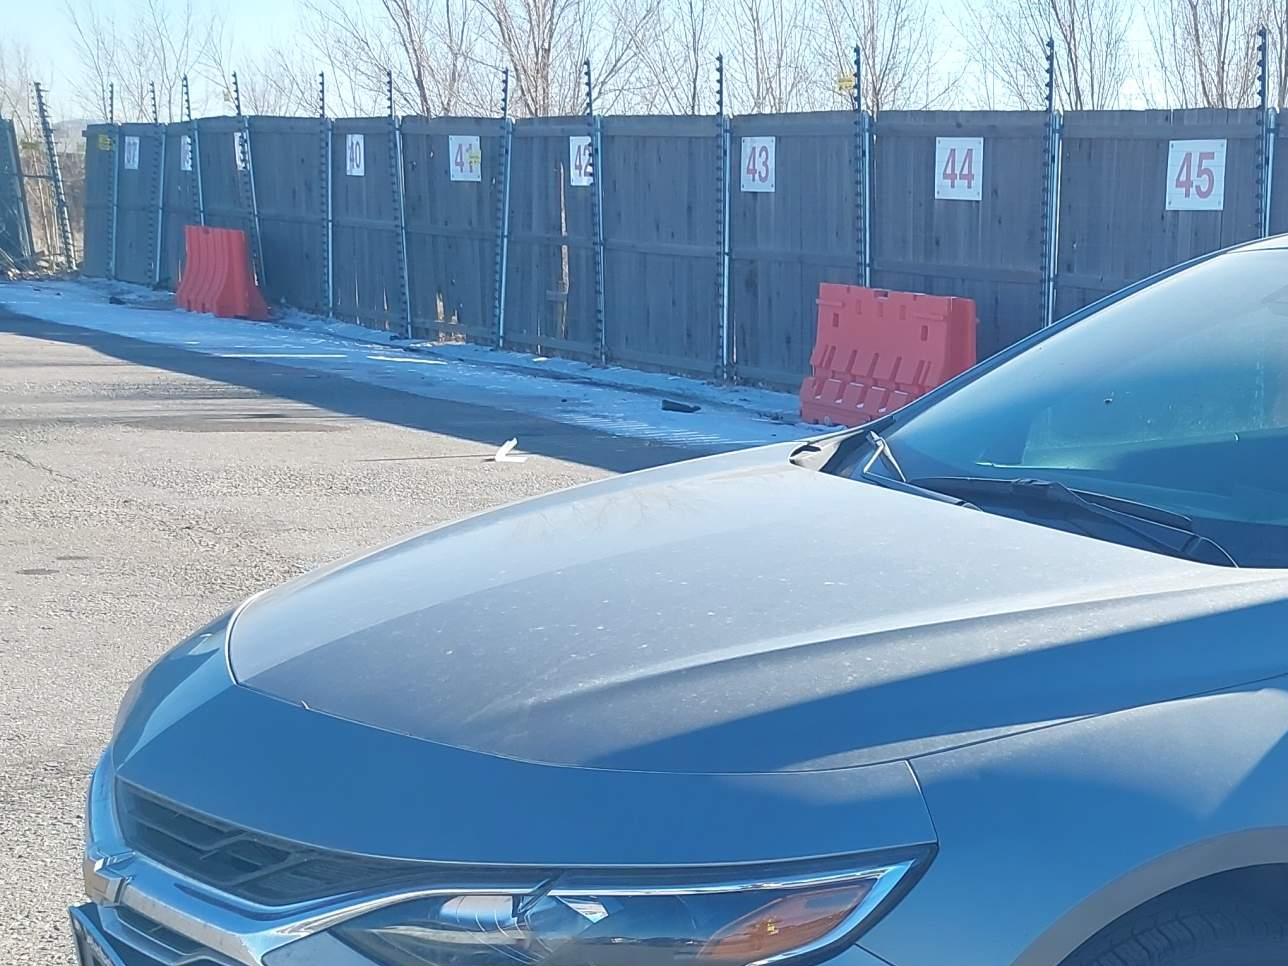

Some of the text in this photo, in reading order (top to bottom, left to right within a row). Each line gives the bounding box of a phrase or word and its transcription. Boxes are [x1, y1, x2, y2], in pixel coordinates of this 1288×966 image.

[746, 145, 770, 183] 43
[942, 147, 975, 189] 44
[1175, 151, 1215, 199] 45
